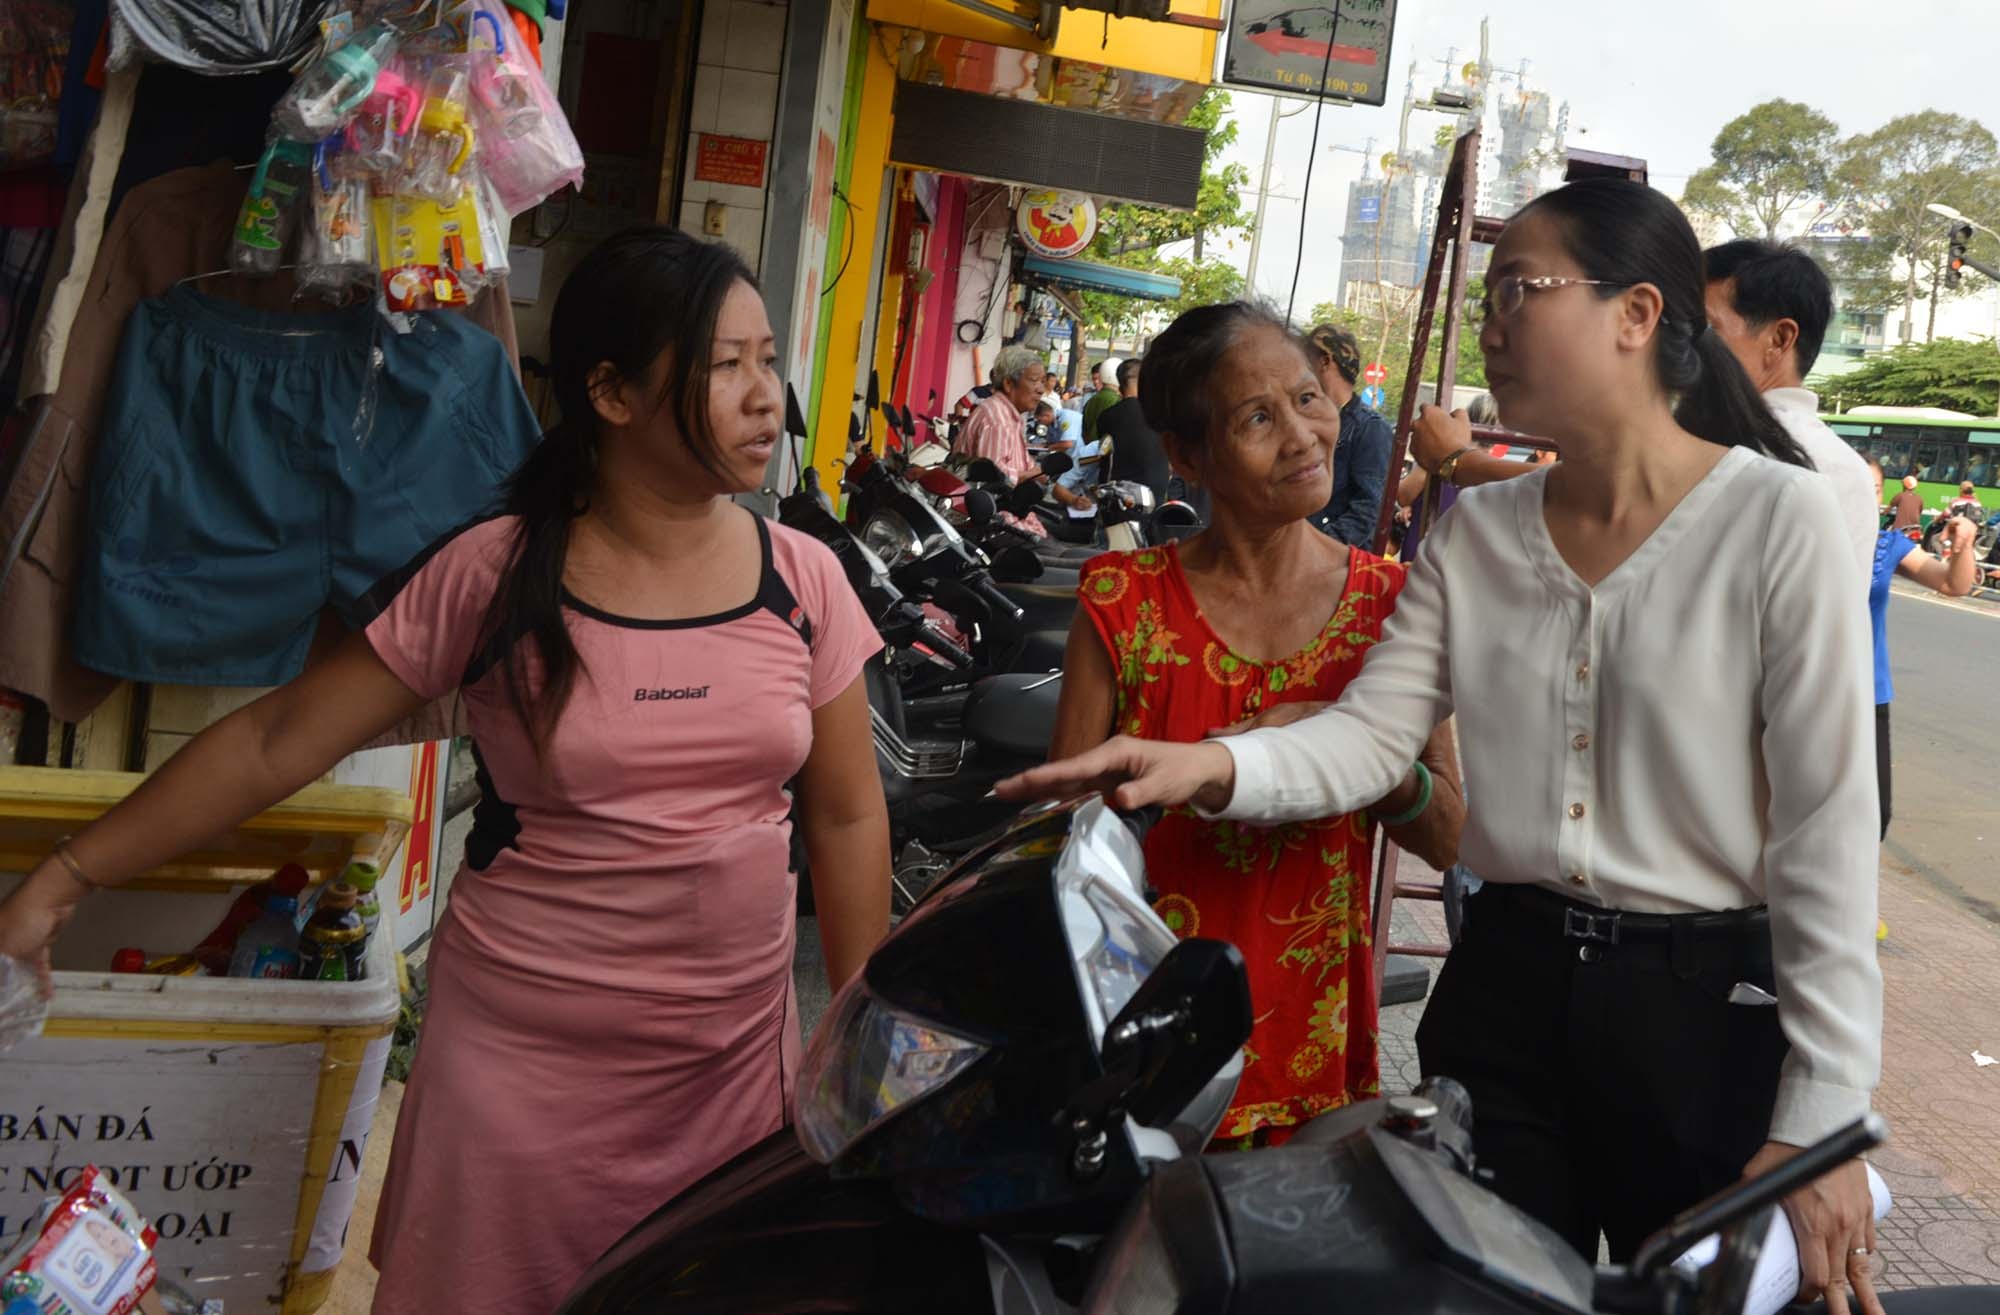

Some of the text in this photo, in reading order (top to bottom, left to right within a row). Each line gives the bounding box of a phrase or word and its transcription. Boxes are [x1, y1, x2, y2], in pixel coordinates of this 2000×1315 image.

[1351, 81, 1369, 95] 30
[0, 1105, 155, 1142] BÁN ĐÁ
[162, 1156, 252, 1193] ƯỚP
[155, 1211, 233, 1246] OẠI
